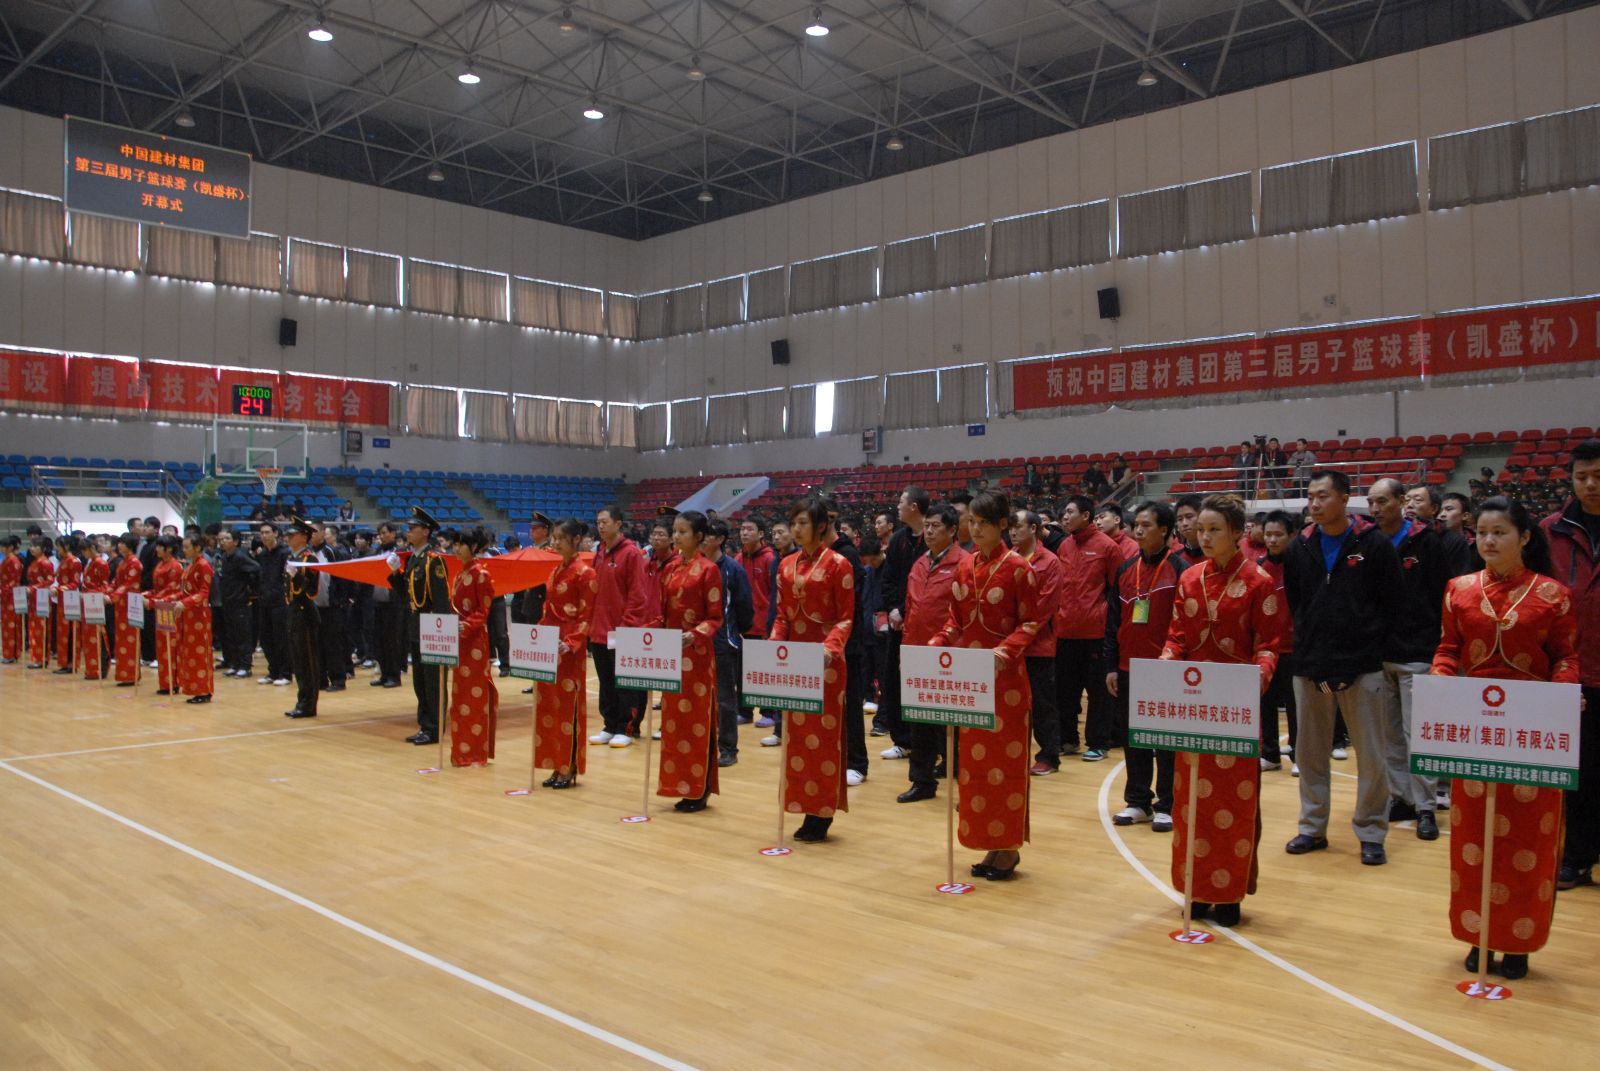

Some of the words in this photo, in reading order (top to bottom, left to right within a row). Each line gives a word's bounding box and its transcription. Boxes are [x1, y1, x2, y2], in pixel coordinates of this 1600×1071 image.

[120, 144, 205, 173] 中国建材集团
[142, 193, 184, 213] 开幕式
[1046, 311, 1600, 398] 预祝中国建材集团第三届男子篮球赛（凯盛杯）
[240, 396, 264, 415] 24
[906, 676, 988, 694] 中国新型建筑材料工业
[918, 691, 976, 707] 杭州设计研究院
[1137, 699, 1252, 725] 西安墙体材料研究设计院
